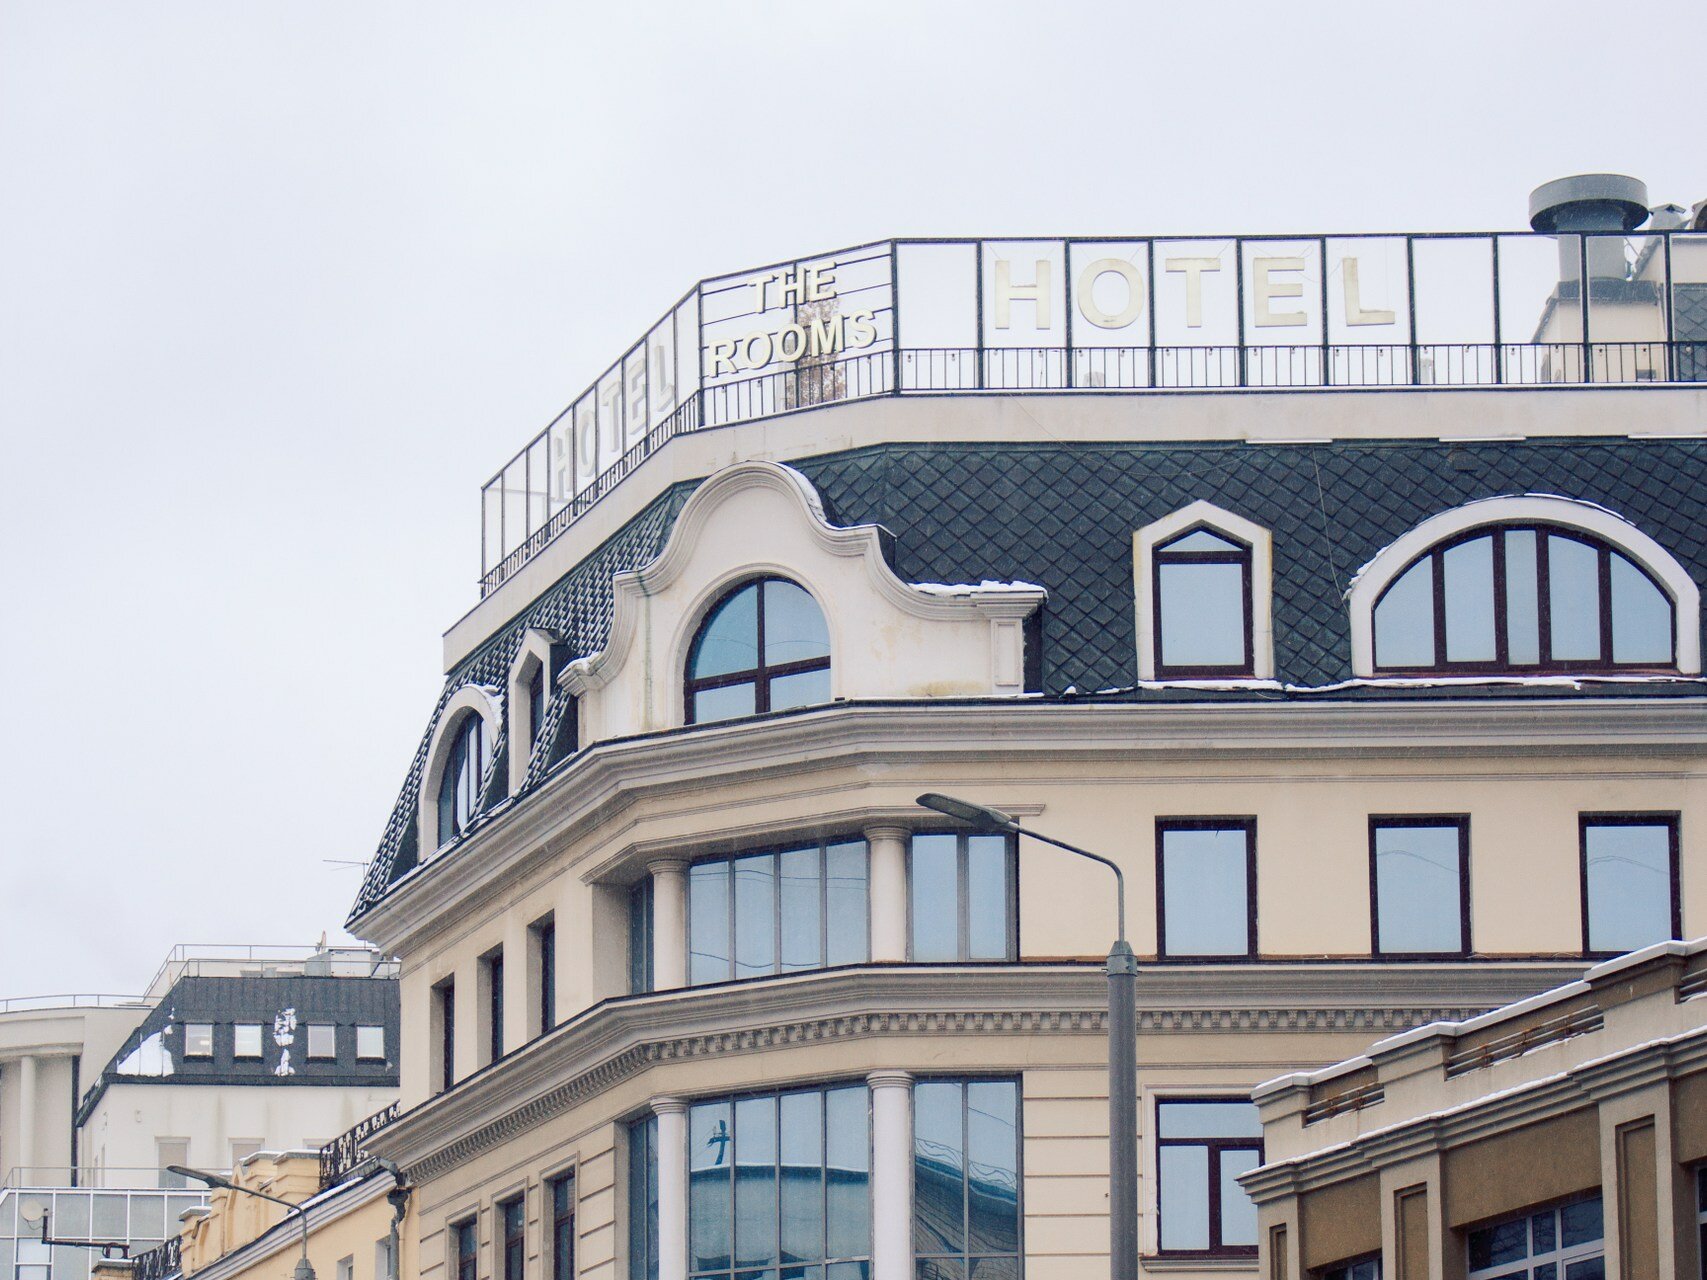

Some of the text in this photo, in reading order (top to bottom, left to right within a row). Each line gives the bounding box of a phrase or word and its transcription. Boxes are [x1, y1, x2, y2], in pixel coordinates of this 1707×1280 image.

[748, 261, 837, 313] THE
[995, 259, 1395, 329] HOTEL
[707, 311, 877, 378] ROOMS
[552, 345, 676, 502] HOTEL
